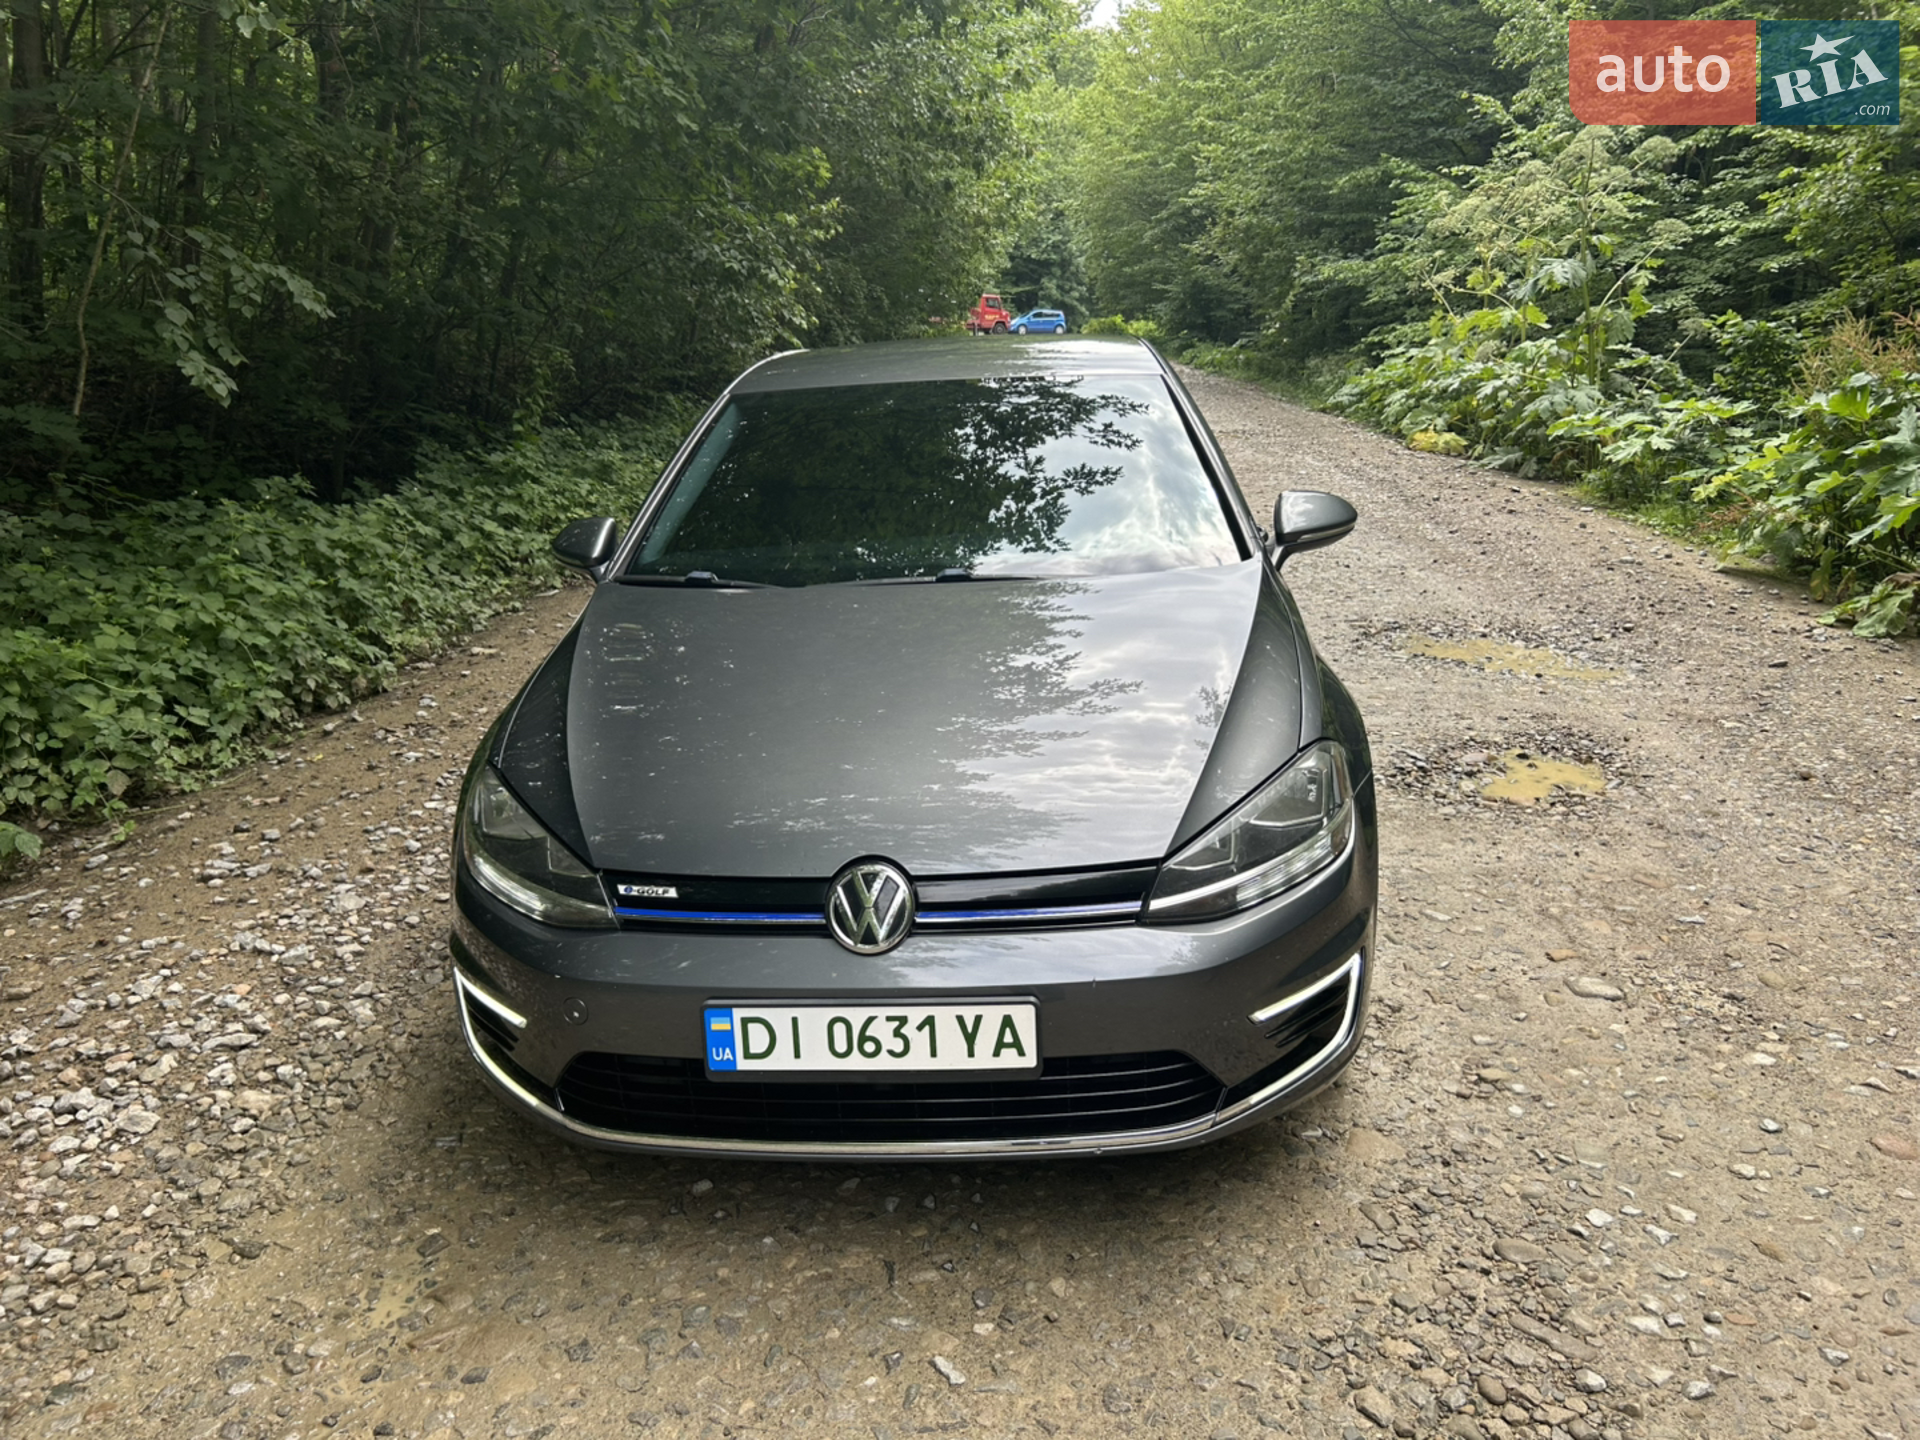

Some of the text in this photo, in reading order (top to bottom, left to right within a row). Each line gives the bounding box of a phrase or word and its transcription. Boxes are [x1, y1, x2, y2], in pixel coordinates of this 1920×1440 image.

[623, 885, 670, 896] e-GOLF
[740, 1014, 1026, 1060] DI 0631 YA
[712, 1047, 734, 1061] UA
